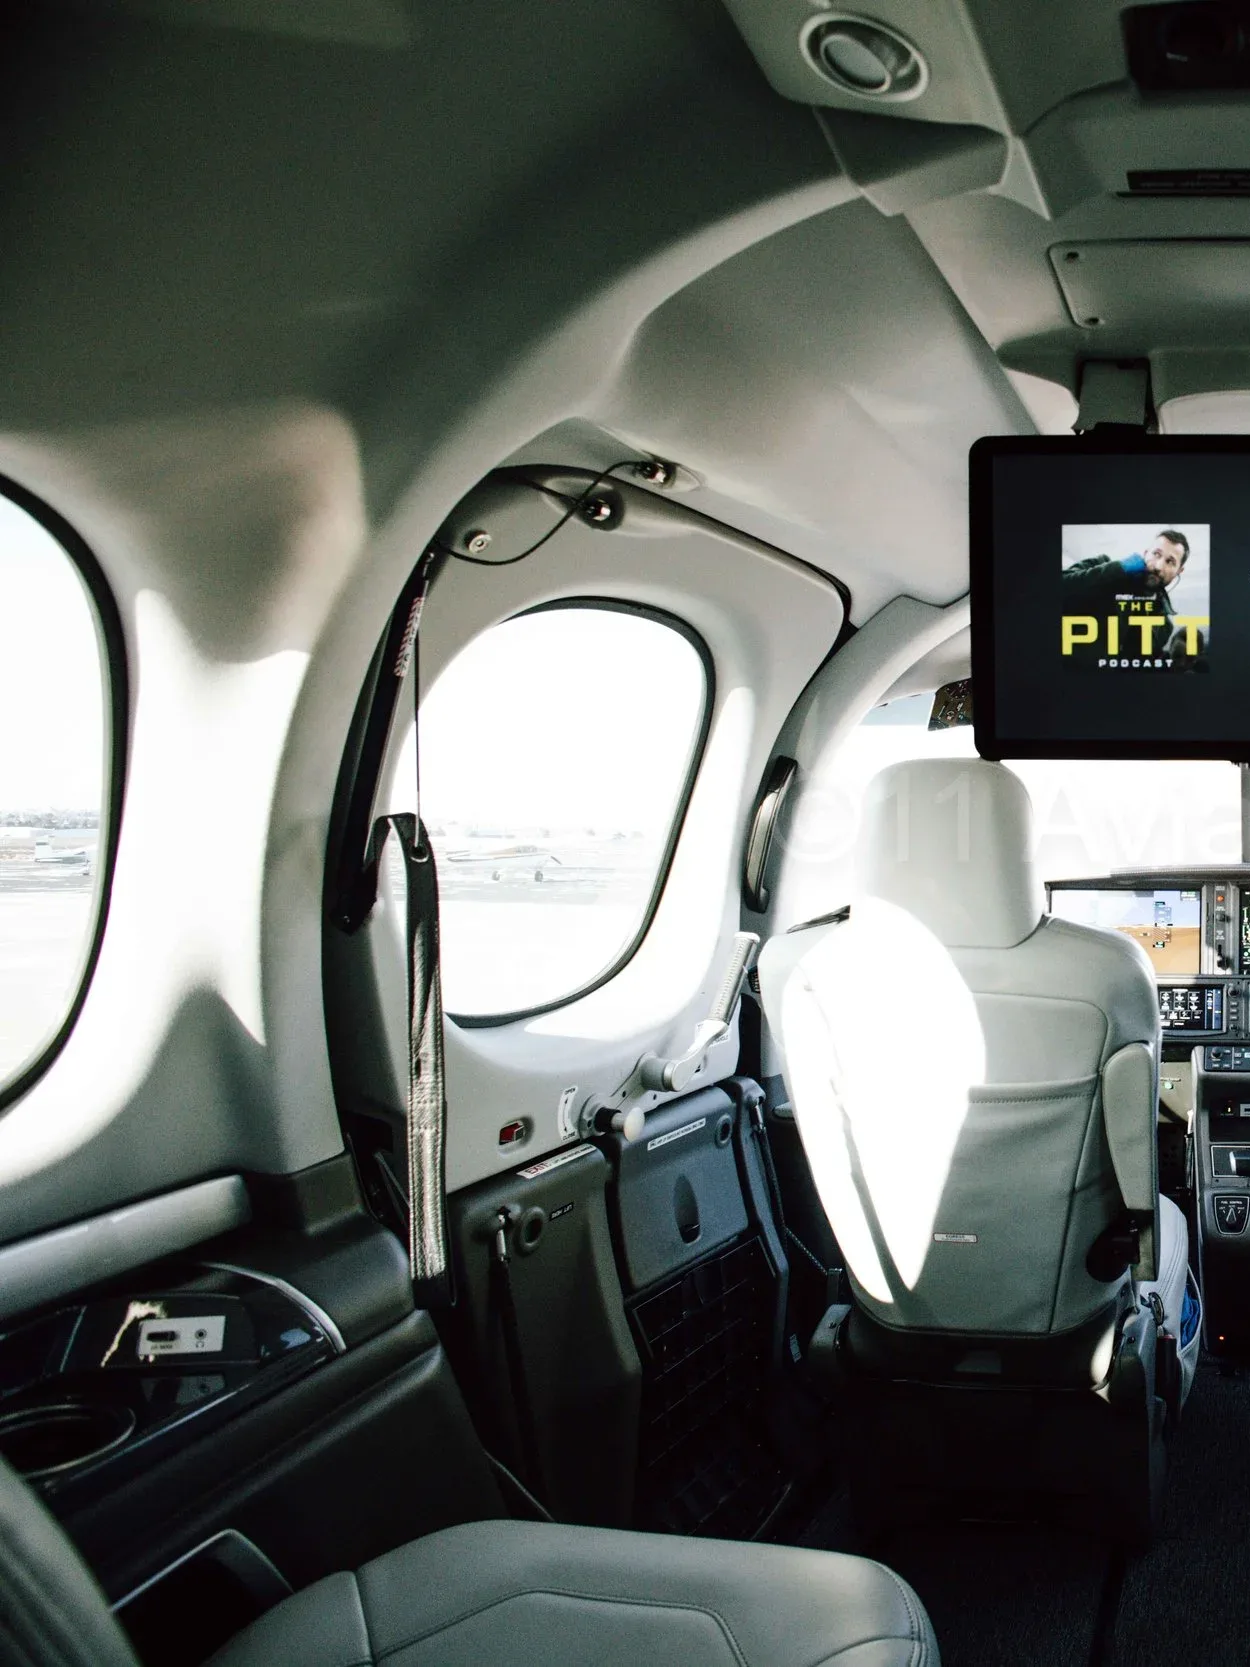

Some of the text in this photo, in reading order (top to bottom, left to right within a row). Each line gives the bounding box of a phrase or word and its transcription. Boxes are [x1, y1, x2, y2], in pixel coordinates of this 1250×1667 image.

[1118, 601, 1154, 611] THE
[1061, 615, 1211, 656] PITT
[1098, 659, 1174, 668] PODCAST
[562, 1131, 576, 1141] CLOSE
